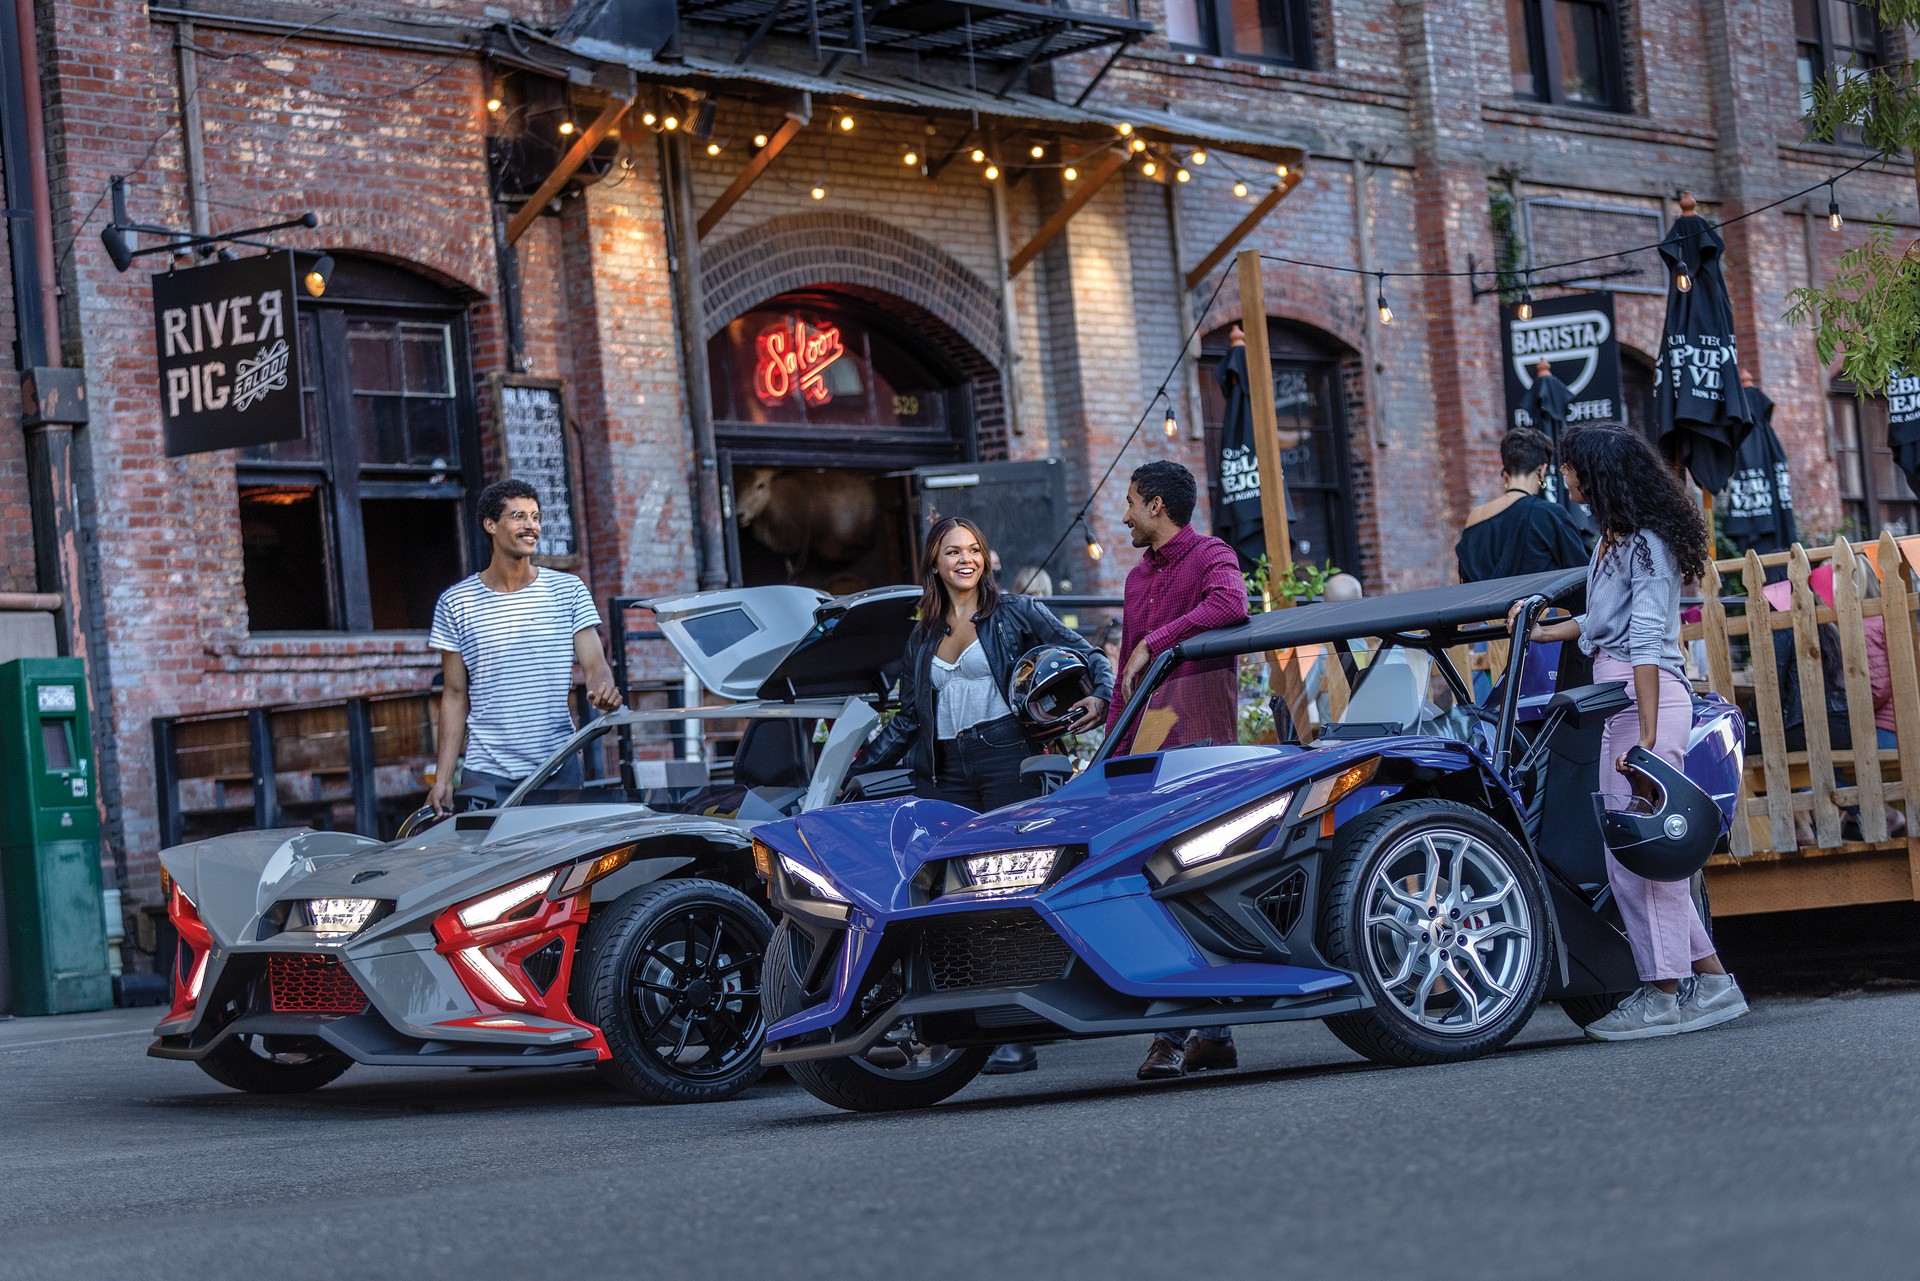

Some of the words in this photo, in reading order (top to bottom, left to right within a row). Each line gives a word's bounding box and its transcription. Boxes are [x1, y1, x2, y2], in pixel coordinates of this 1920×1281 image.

[163, 289, 284, 357] RIVER
[1511, 323, 1598, 355] BARISTA
[234, 351, 289, 396] SALOON
[765, 321, 843, 397] Saloon
[166, 361, 231, 417] PIG
[892, 396, 919, 415] 529
[1565, 399, 1613, 422] OFFEE
